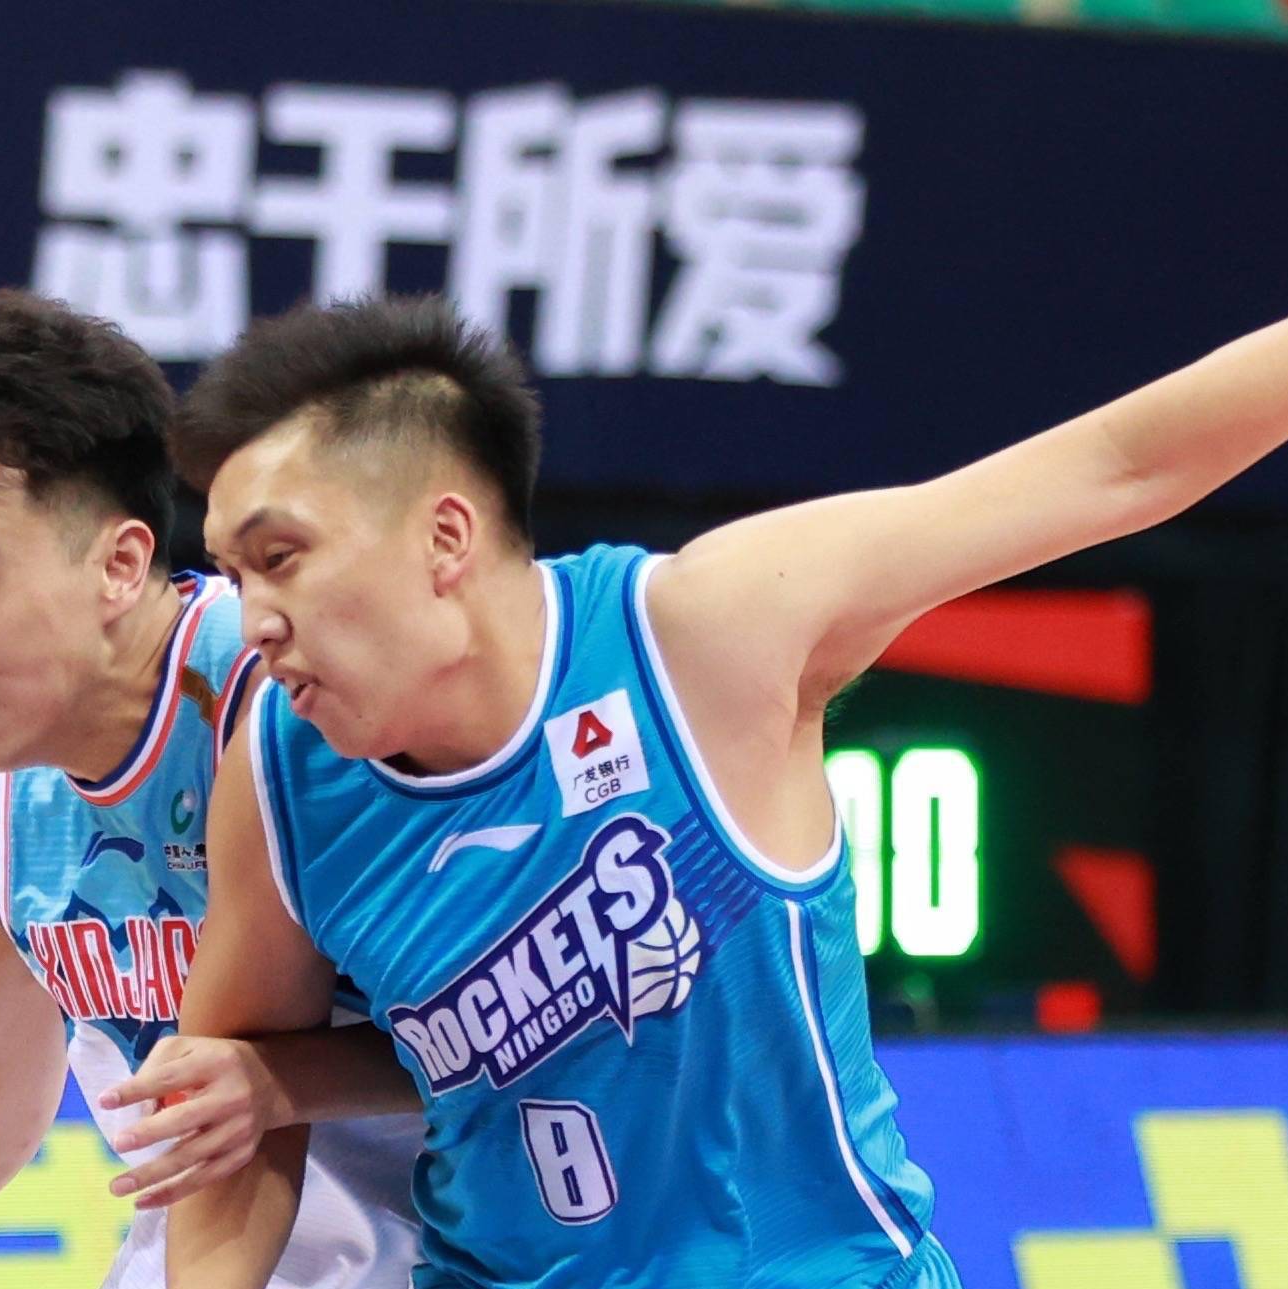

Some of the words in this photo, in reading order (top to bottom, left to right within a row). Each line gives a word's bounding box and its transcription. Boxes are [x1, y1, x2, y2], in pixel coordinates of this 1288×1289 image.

[31, 68, 867, 387] 忠于所爱
[573, 754, 631, 791] 广发银行
[584, 777, 622, 804] CGB
[27, 915, 206, 1021] XINJAN
[393, 829, 657, 1083] ROCKETS
[492, 975, 597, 1077] NINGBO
[518, 1099, 619, 1227] 8
